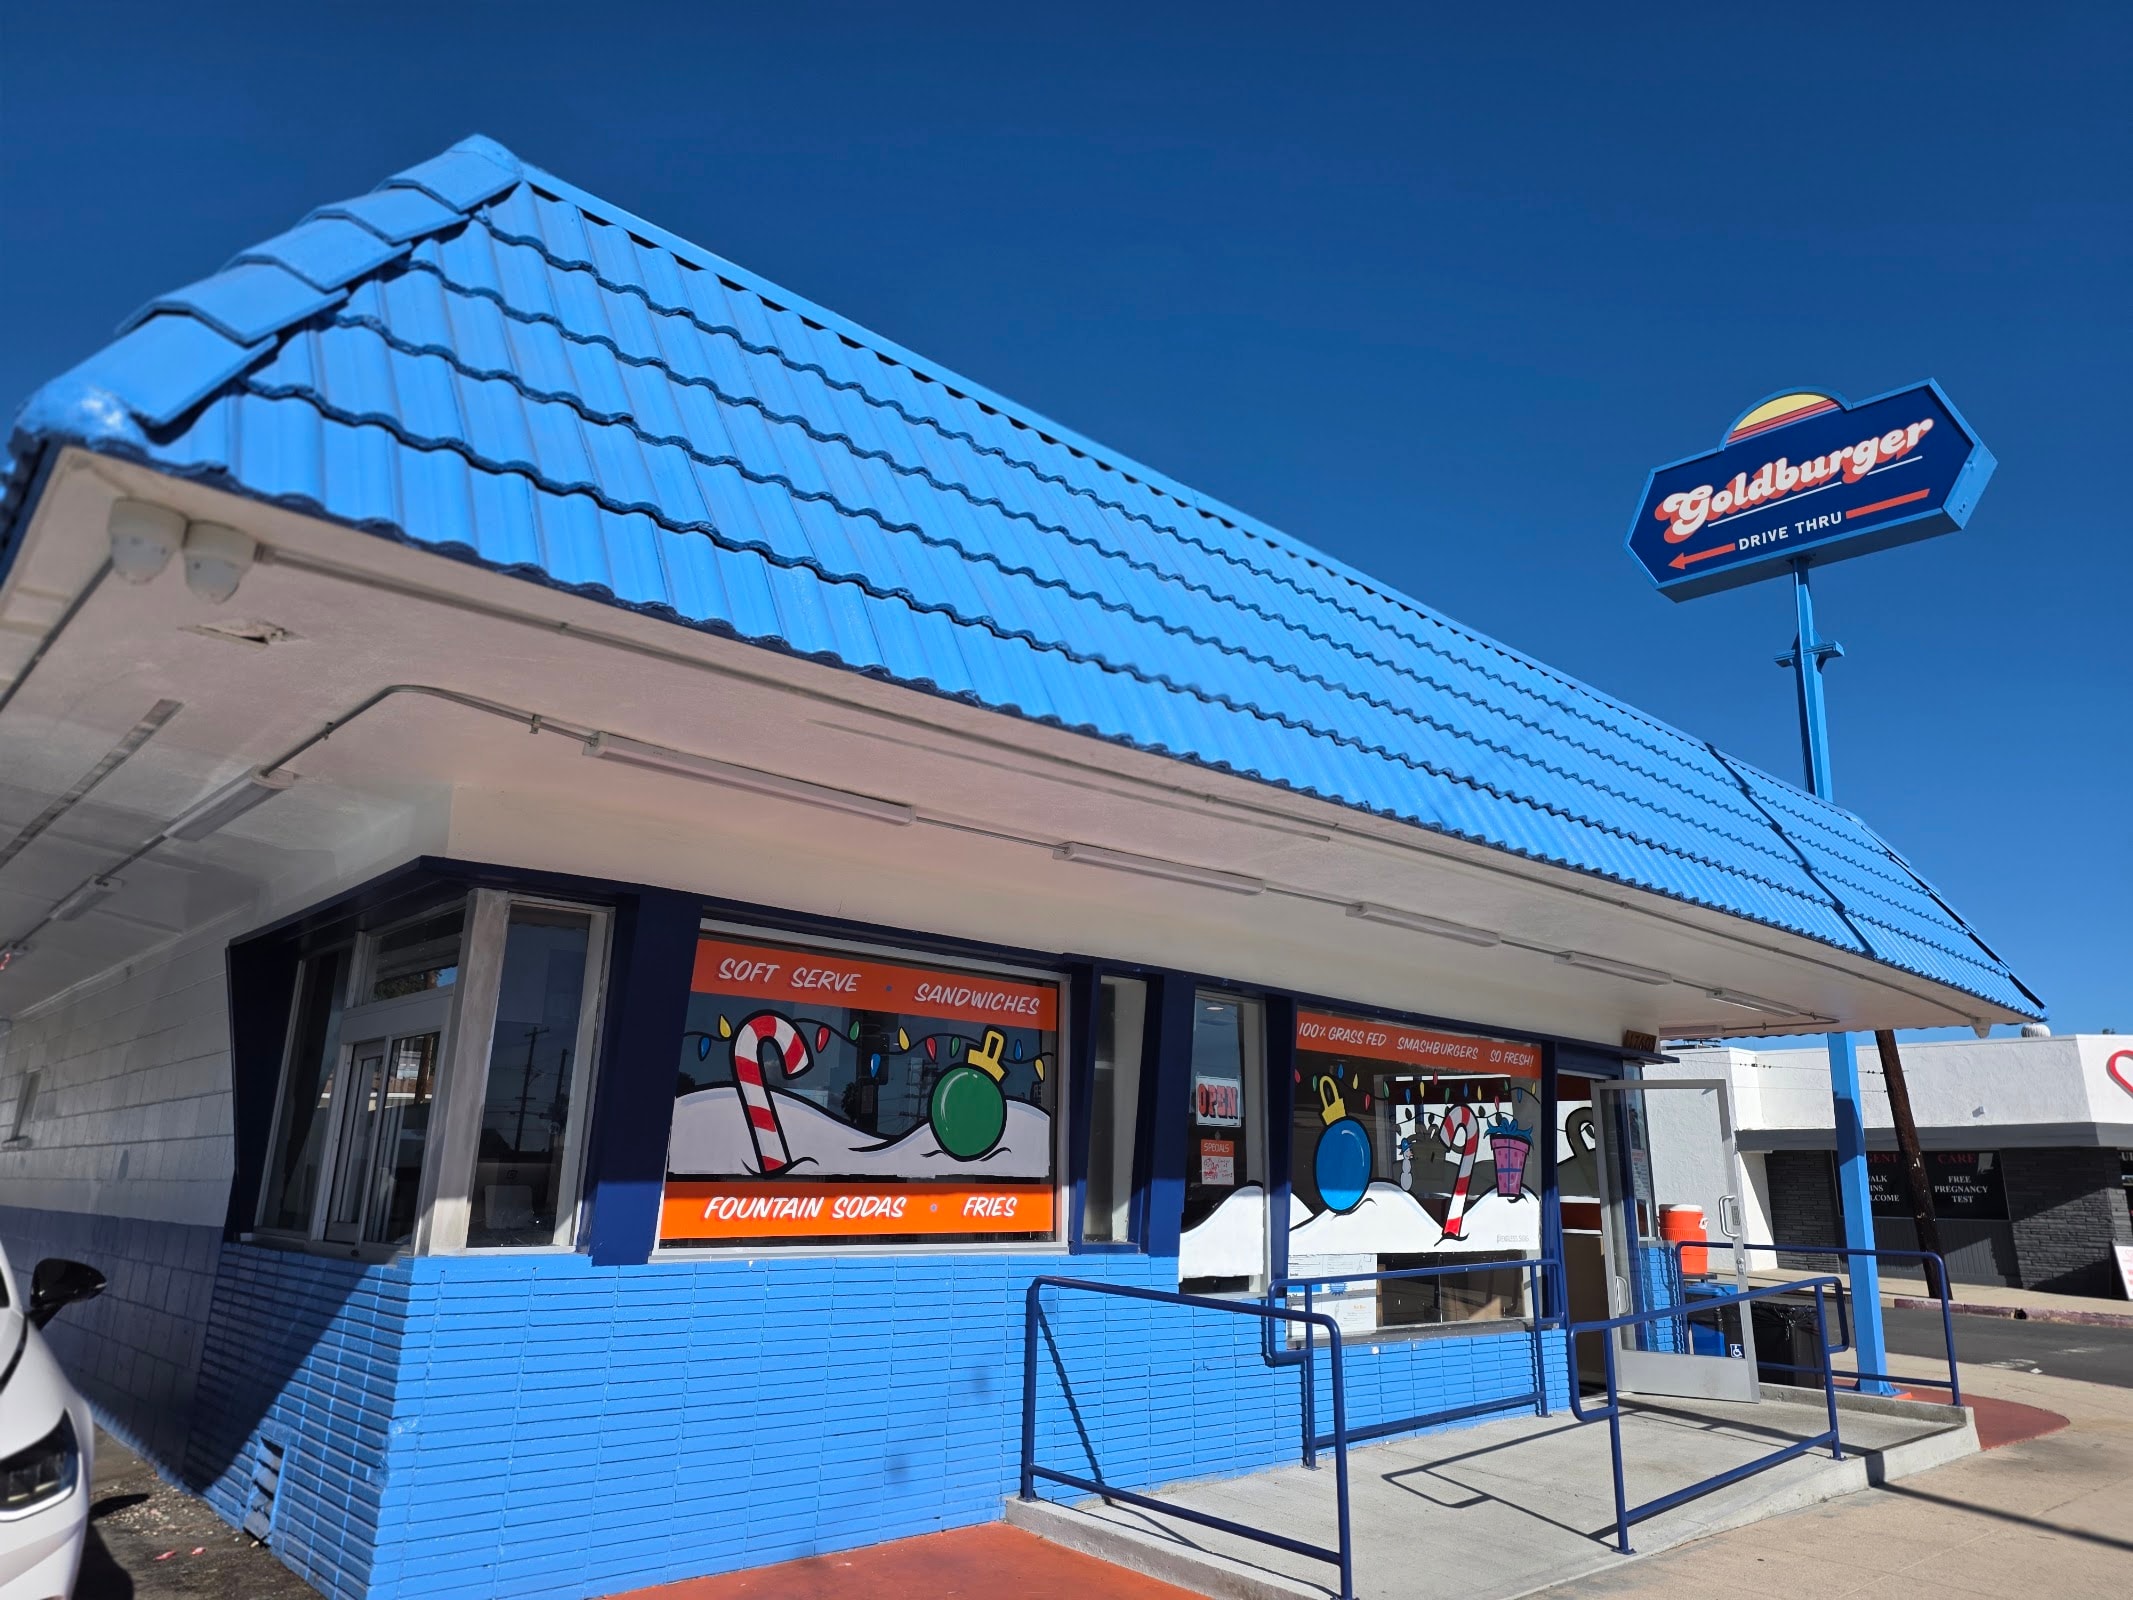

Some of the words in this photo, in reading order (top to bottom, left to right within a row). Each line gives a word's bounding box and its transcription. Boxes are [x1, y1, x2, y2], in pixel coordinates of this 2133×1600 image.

[1655, 418, 1935, 544] Goldburger
[1738, 526, 1790, 551] DRIVE
[1794, 511, 1843, 535] THRU
[718, 957, 780, 984] SOFT
[790, 967, 862, 993] SERVE
[914, 982, 1041, 1016] SANDWICHES
[1299, 1022, 1326, 1038] 100%
[1328, 1026, 1365, 1045] GRASS
[1365, 1032, 1387, 1047] FED
[1396, 1036, 1479, 1060] SMASHBURGERS
[1489, 1049, 1502, 1063] SO
[1503, 1051, 1534, 1068] FRESH!
[1198, 1083, 1239, 1120] OPEN
[1937, 1152, 1976, 1165] CARE
[1934, 1185, 1988, 1194] PREGNANCY
[1948, 1175, 1972, 1184] FREE
[704, 1197, 824, 1219] FOUNTAIN
[832, 1196, 907, 1219] SODAS
[962, 1196, 1018, 1217] FRIES
[1870, 1194, 1900, 1202] LCOME
[1951, 1195, 1974, 1204] TEST
